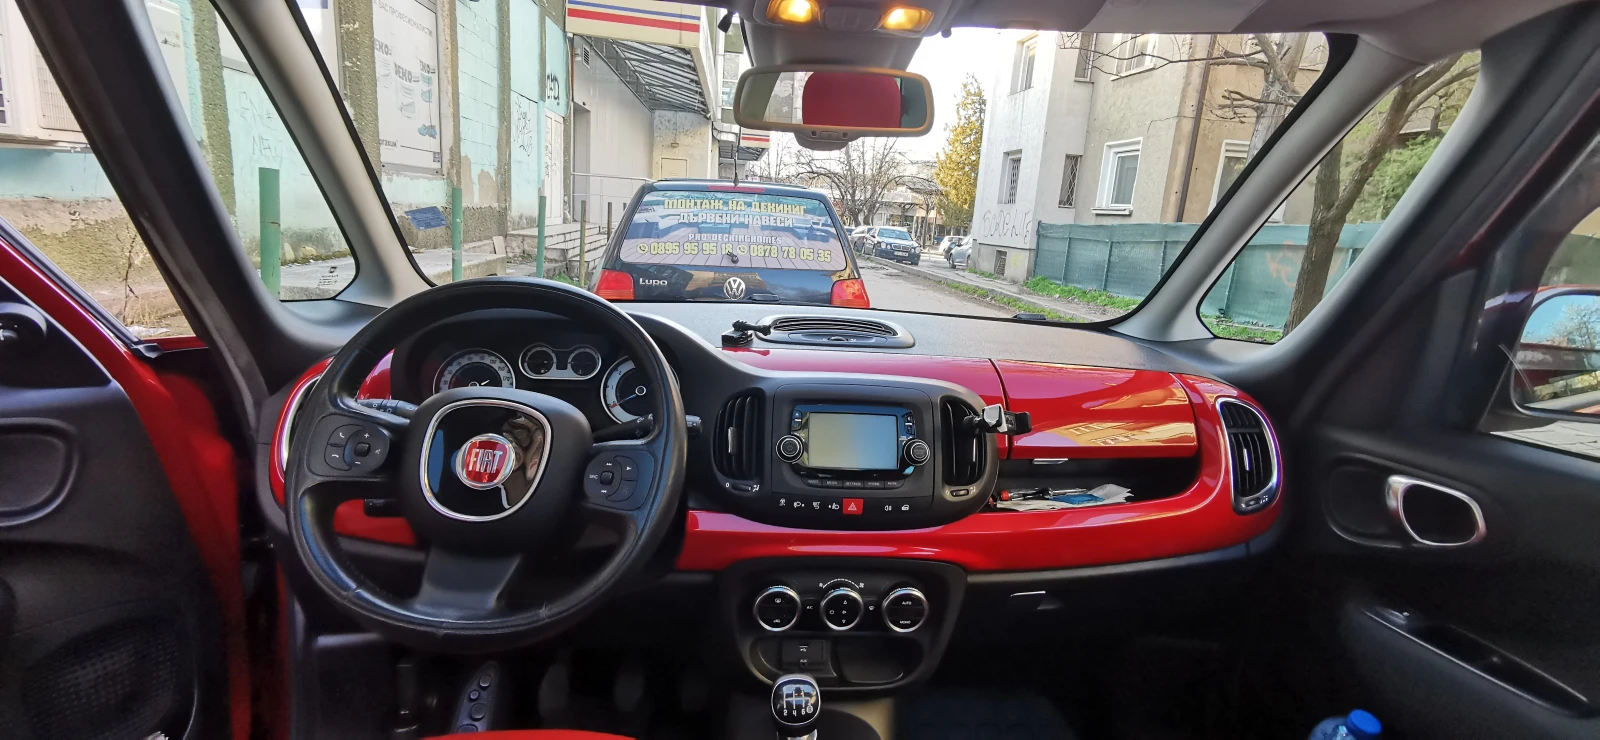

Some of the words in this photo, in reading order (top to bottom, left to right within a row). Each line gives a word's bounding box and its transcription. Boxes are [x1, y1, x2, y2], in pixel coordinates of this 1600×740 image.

[663, 199, 724, 210] МОНТАЖ
[728, 200, 745, 211] НА
[678, 211, 740, 224] ДЪРВЕНИ
[744, 214, 794, 228] НАВЕСИ
[650, 242, 680, 255] 0895
[683, 242, 699, 255] 95
[702, 242, 718, 255] 95
[721, 243, 733, 255] 18
[749, 243, 778, 258] 0878
[781, 246, 796, 259] 78
[799, 247, 814, 261] 05
[817, 249, 832, 263] 35
[639, 277, 668, 286] Lupo
[468, 448, 503, 474] FIAT
[792, 709, 797, 717] 4
